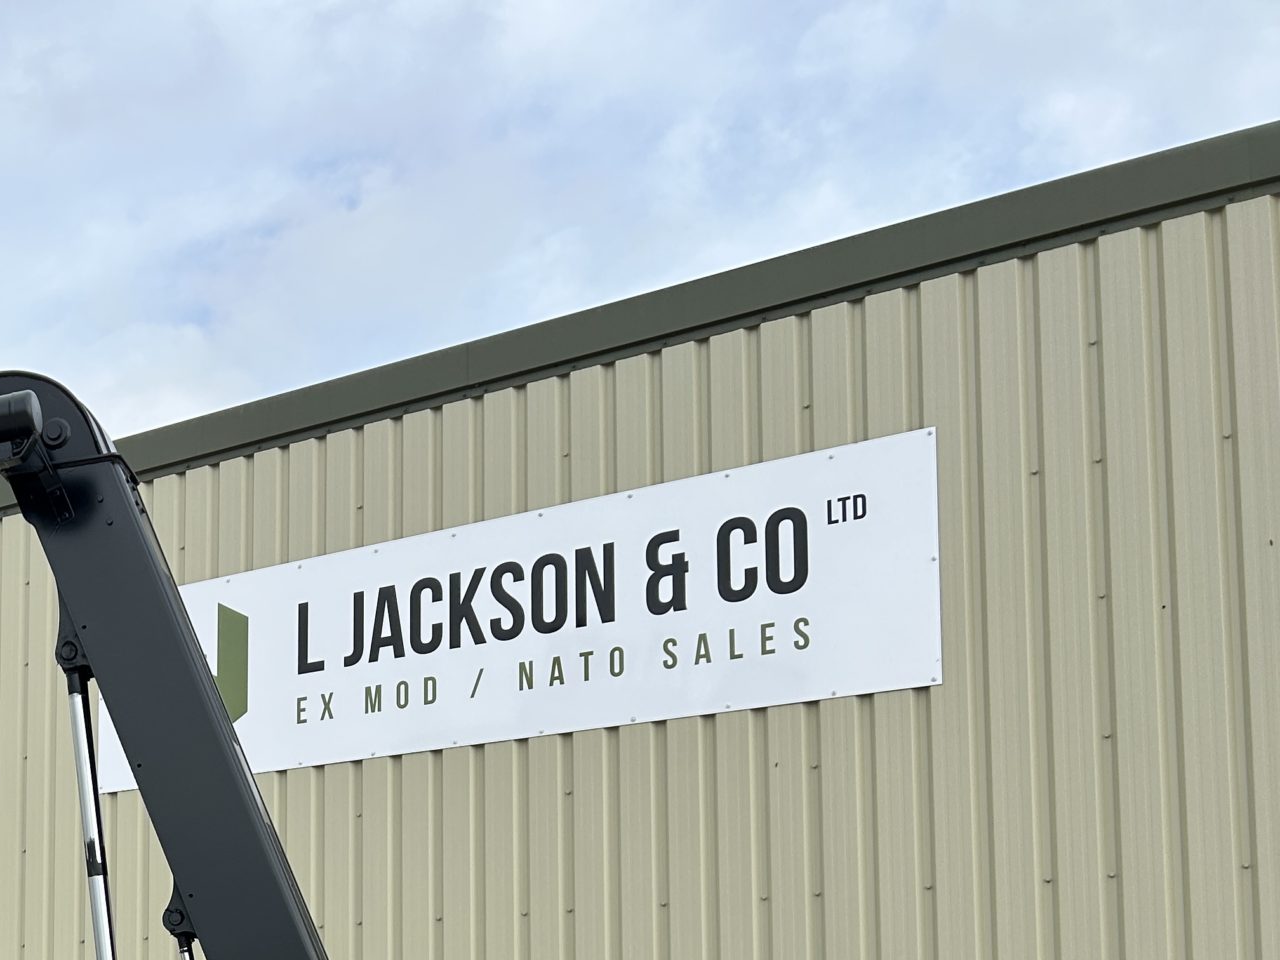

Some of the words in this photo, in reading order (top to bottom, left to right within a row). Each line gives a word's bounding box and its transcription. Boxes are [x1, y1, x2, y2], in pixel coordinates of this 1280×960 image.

[297, 601, 325, 676] L
[343, 541, 616, 668] JACKSON
[645, 528, 690, 616] &
[716, 506, 809, 603] CO
[826, 493, 868, 526] LTD
[296, 693, 334, 725] EX
[364, 676, 438, 714] MOD
[470, 668, 484, 699] /
[518, 645, 625, 692] NATO
[662, 617, 811, 670] SALES
